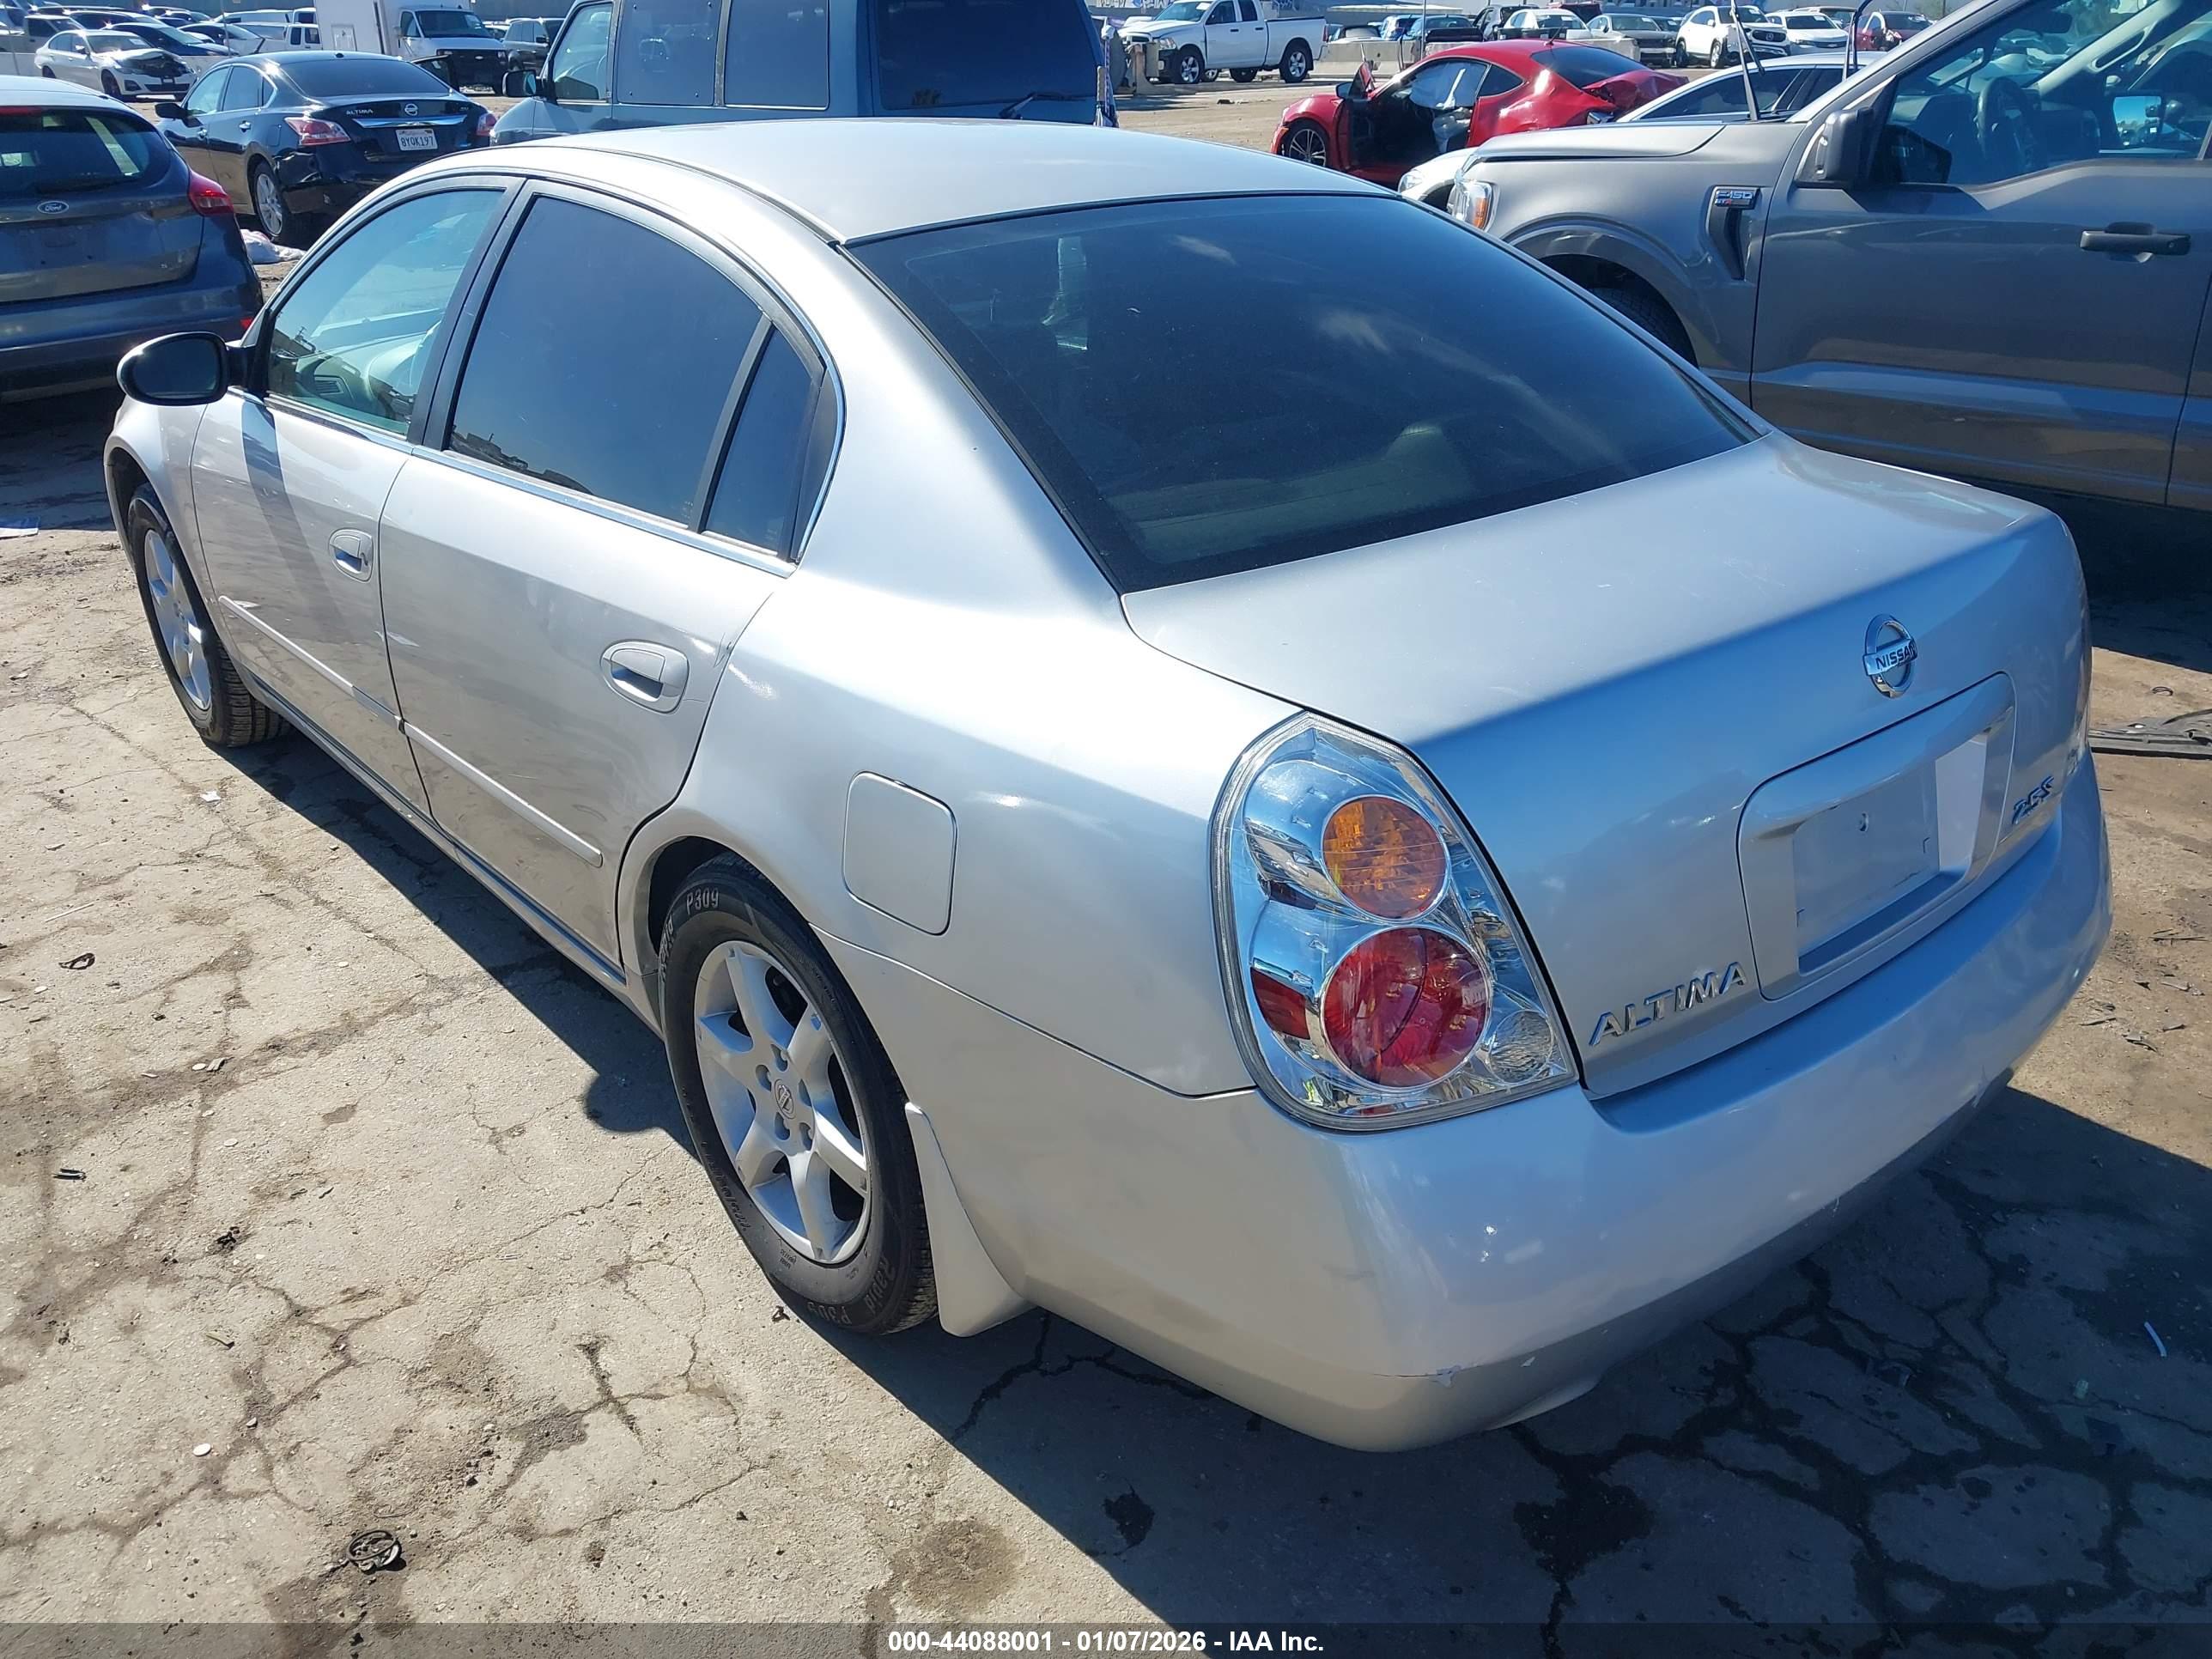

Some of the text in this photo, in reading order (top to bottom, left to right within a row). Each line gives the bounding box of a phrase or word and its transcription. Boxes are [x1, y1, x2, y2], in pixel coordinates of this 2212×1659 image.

[1875, 644, 1917, 670] NISSAN
[686, 887, 720, 915] P309
[1589, 961, 1747, 1046] ALTIMA
